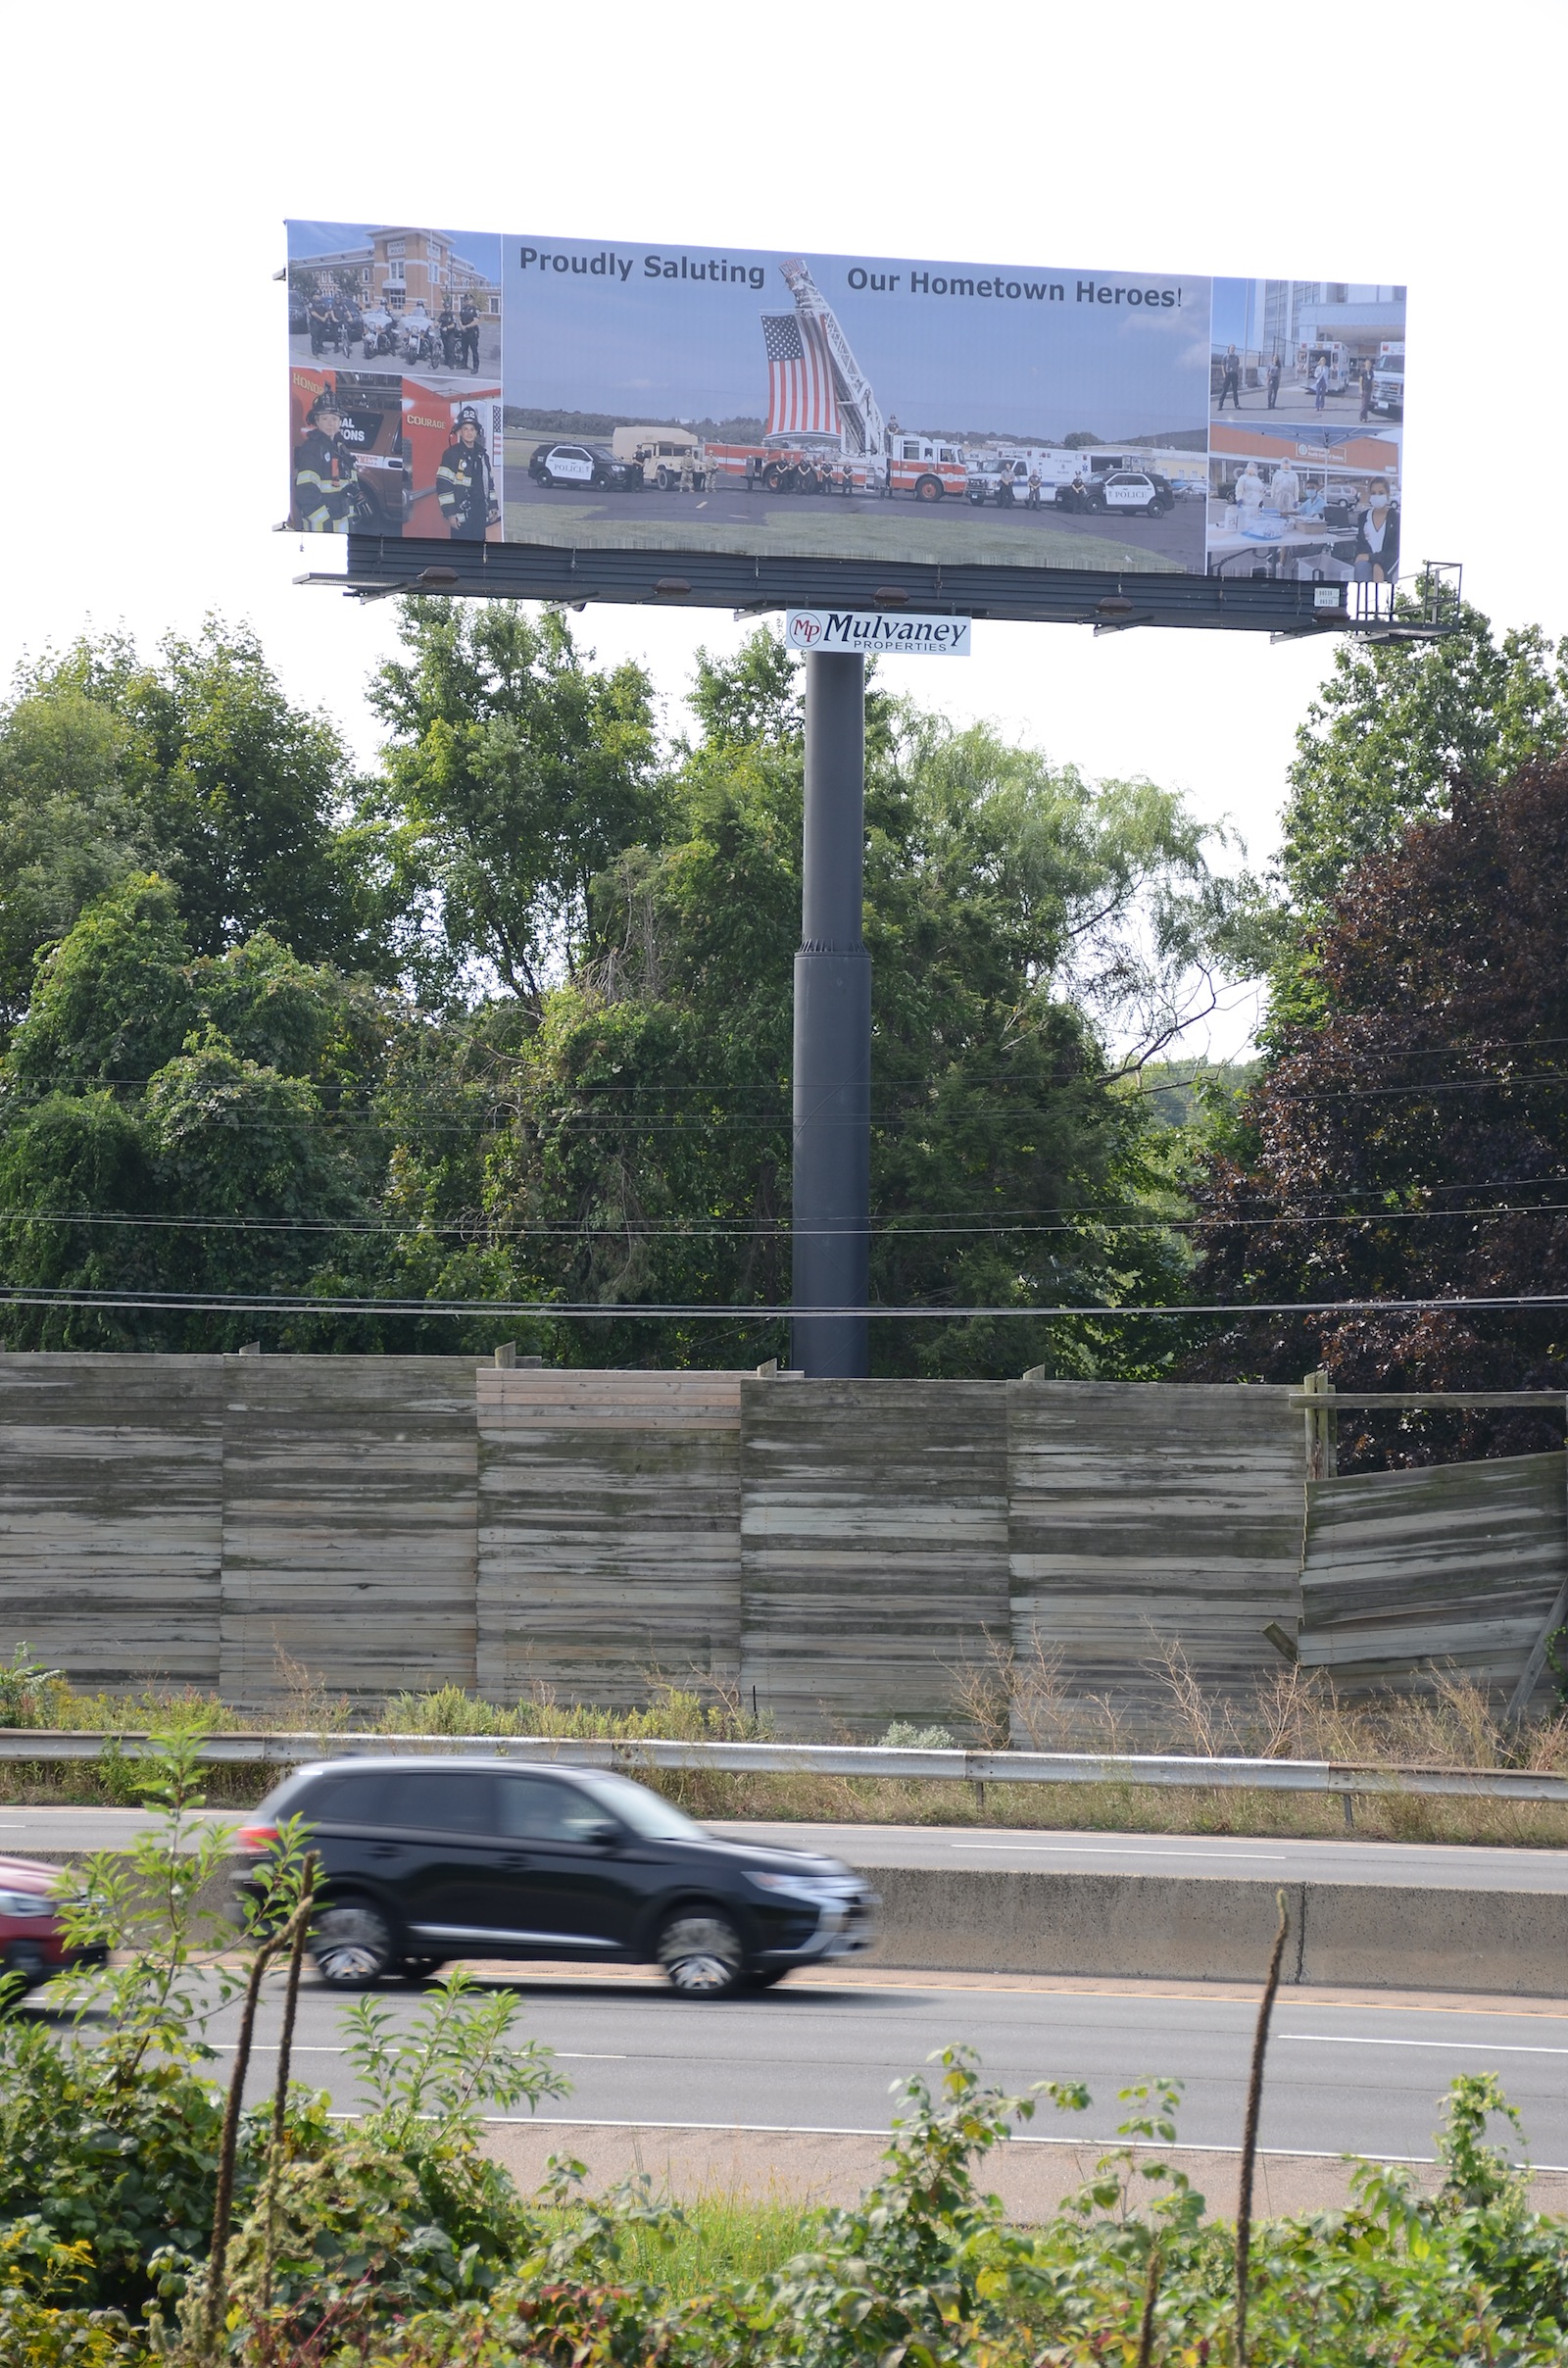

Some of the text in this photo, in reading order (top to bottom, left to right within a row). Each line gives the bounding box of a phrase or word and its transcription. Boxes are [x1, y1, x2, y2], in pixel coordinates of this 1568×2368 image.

[519, 246, 1182, 308] Proudly Saluting Our Hometown Heroes!
[463, 410, 475, 419] 22
[406, 414, 446, 429] COURAGE
[554, 463, 585, 473] POLICE
[823, 613, 967, 648] Mulvaney
[854, 640, 948, 652] PROPERTIES
